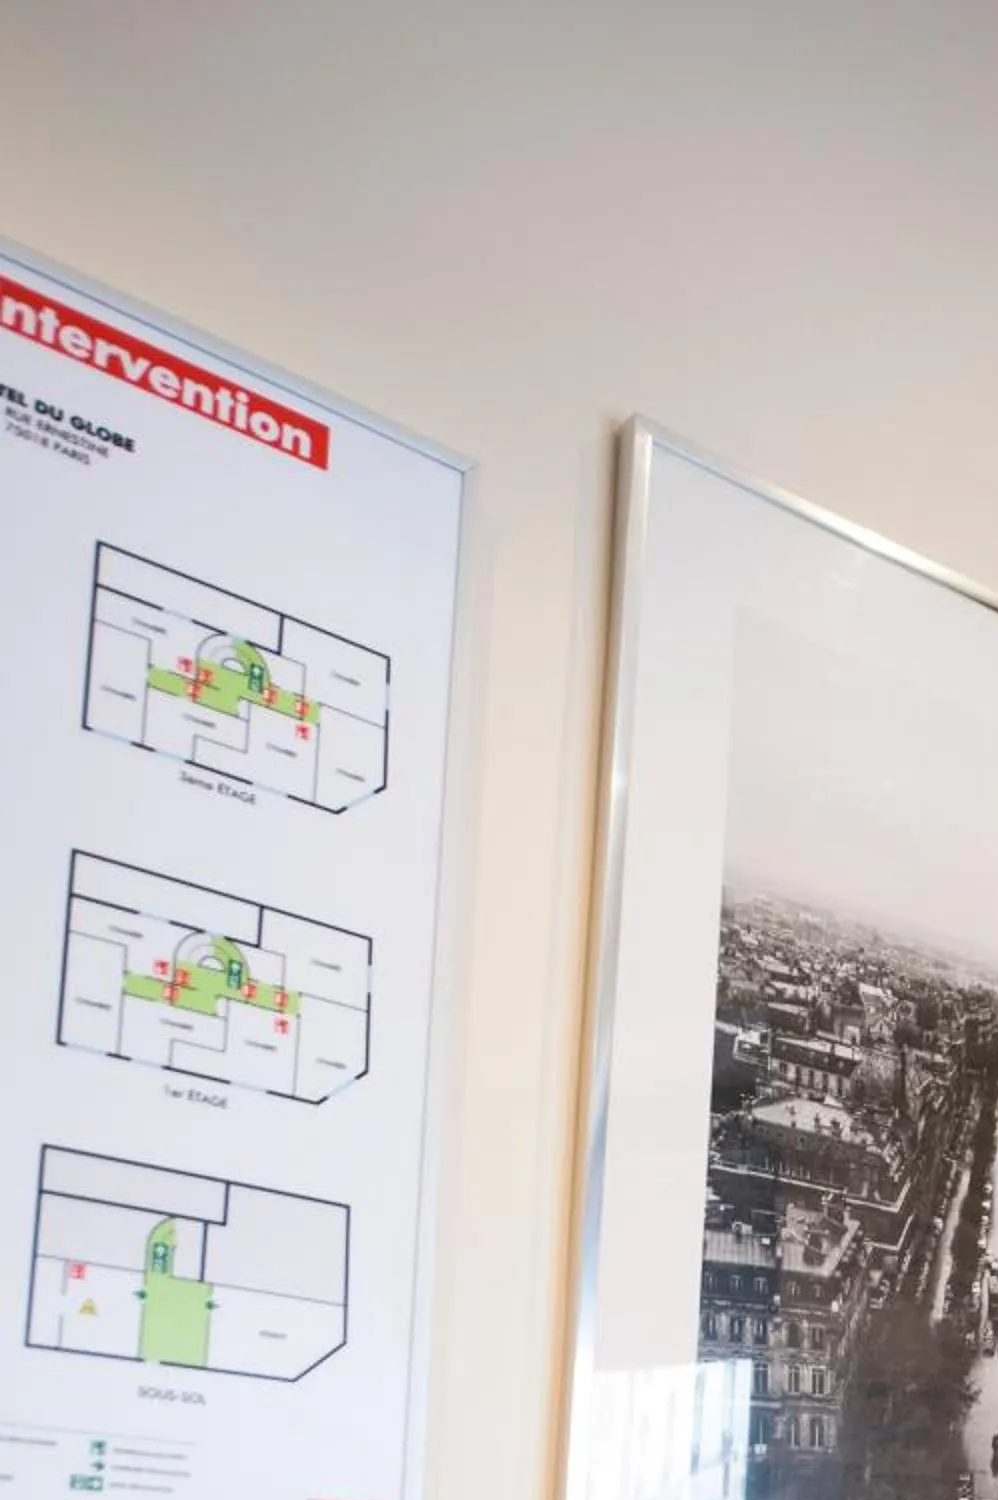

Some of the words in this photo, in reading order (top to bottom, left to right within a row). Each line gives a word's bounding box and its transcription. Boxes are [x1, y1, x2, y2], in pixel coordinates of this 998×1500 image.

[5, 406, 31, 424] RUE
[34, 399, 63, 422] DU
[70, 415, 136, 453] GLOBE
[53, 440, 90, 465] PARIS
